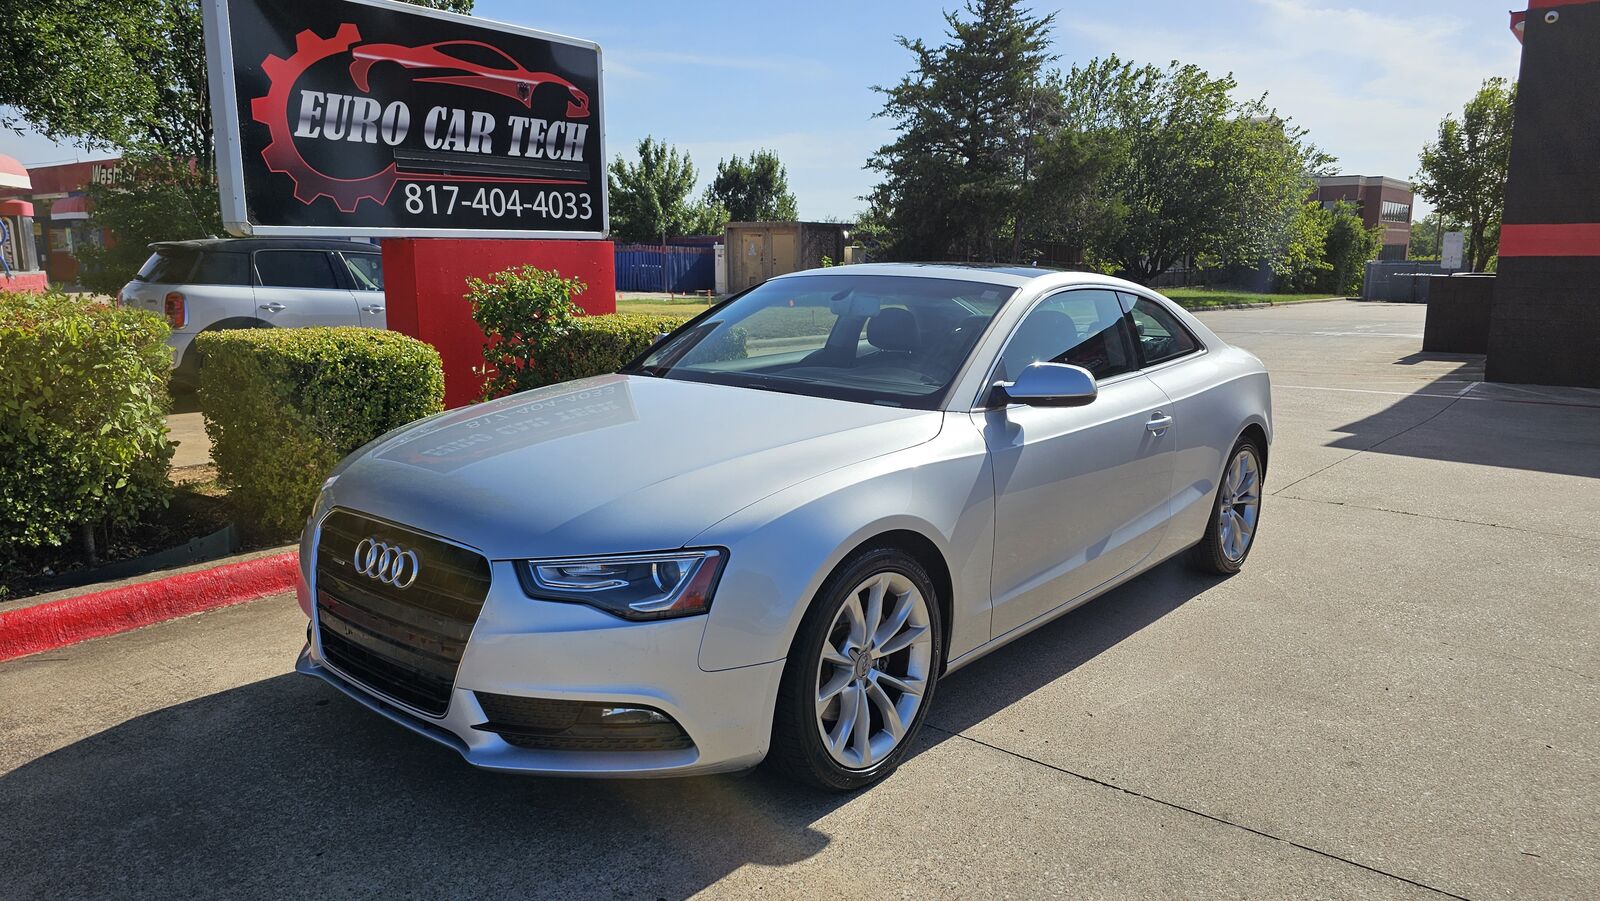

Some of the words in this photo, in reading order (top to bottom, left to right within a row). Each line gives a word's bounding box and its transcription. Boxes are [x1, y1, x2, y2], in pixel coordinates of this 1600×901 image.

[294, 89, 410, 146] EURO
[424, 106, 496, 154] CAR
[508, 115, 589, 162] TECH
[404, 183, 593, 220] 817-404-4033
